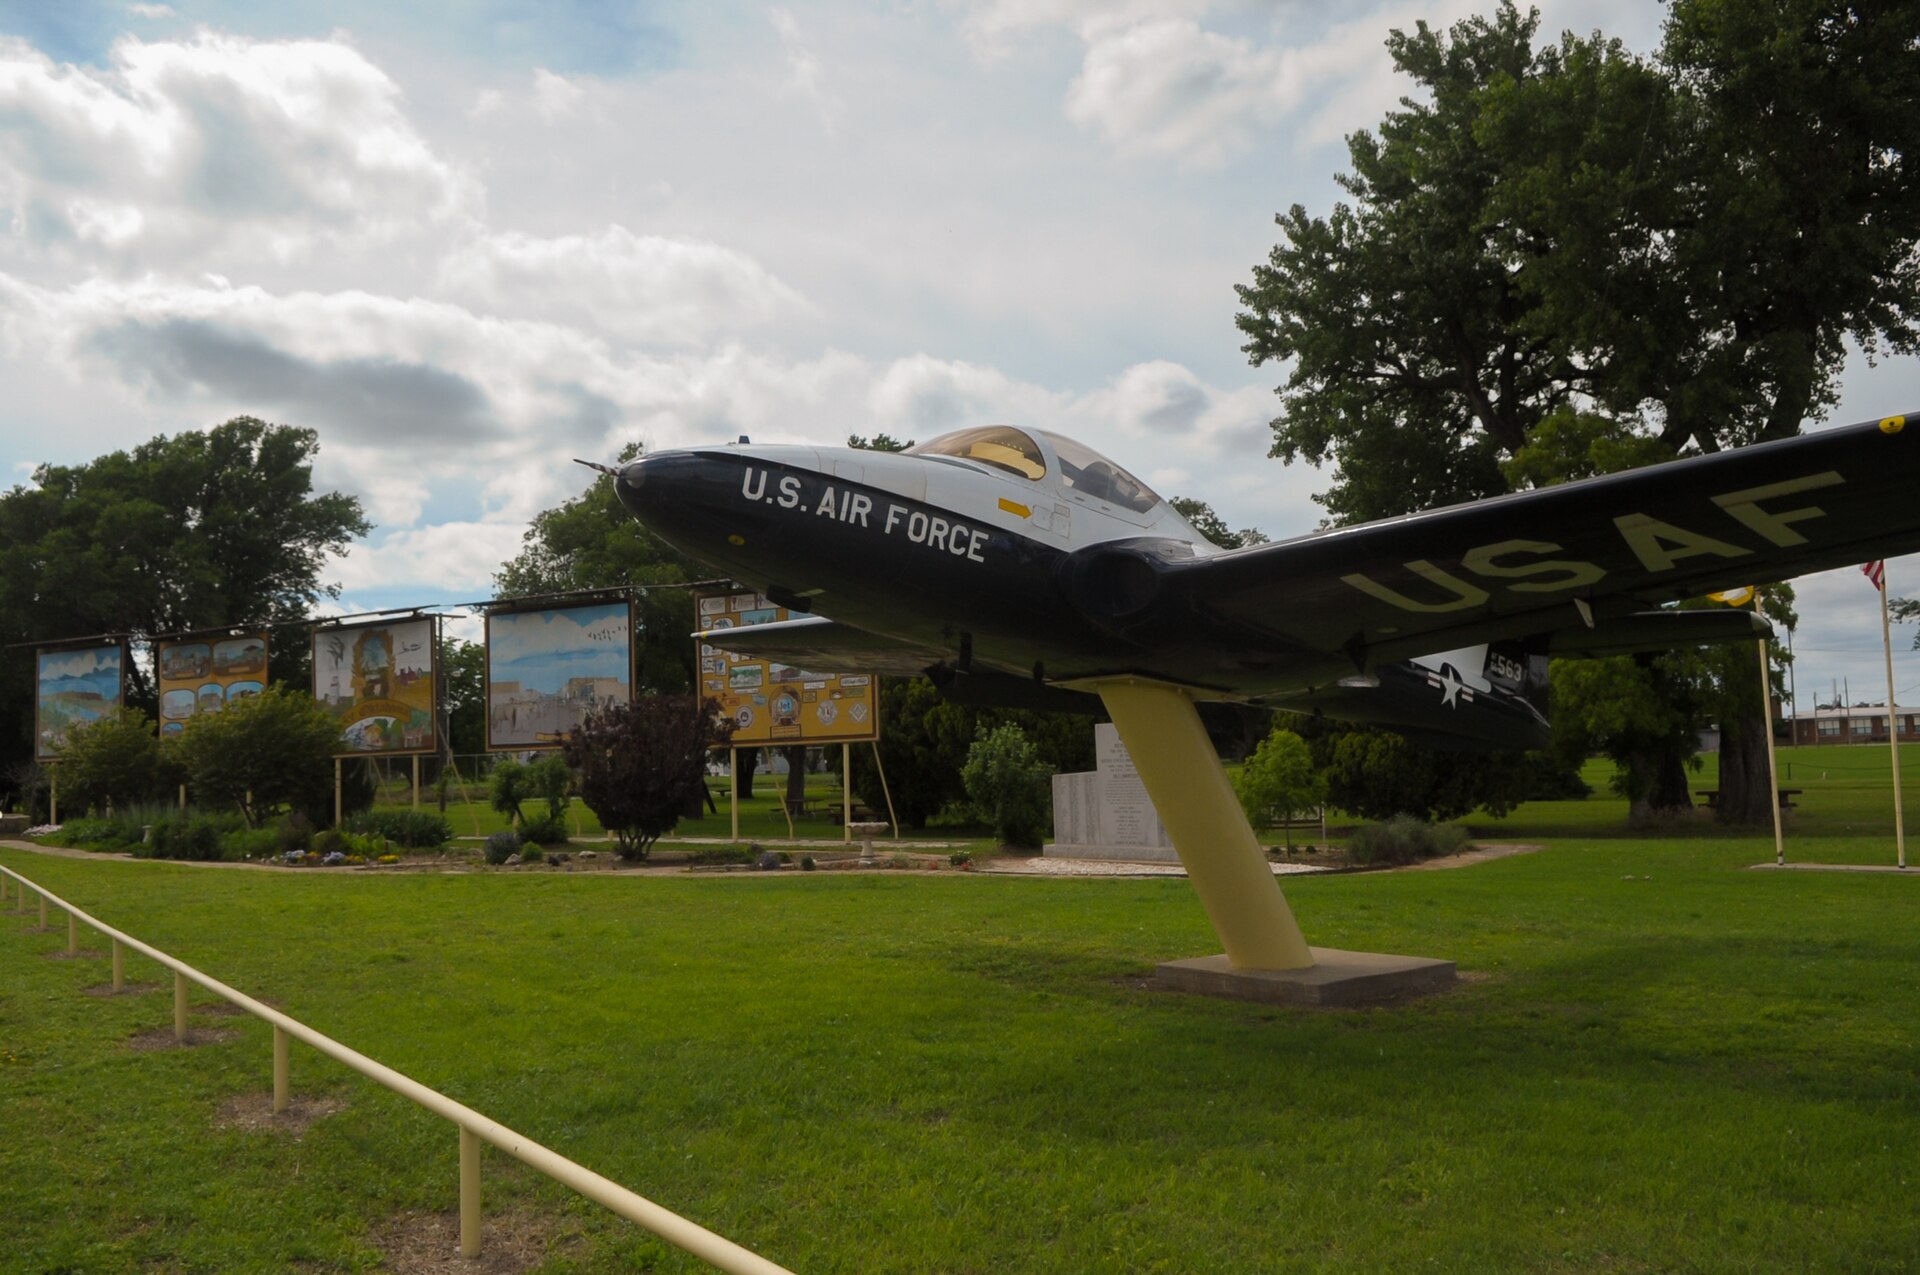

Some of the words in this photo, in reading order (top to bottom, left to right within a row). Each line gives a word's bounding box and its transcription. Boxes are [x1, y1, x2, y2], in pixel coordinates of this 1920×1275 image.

[742, 467, 807, 512] U.S.
[816, 487, 872, 528] AIR
[884, 504, 990, 563] FORCE
[1340, 470, 1846, 613] USAF
